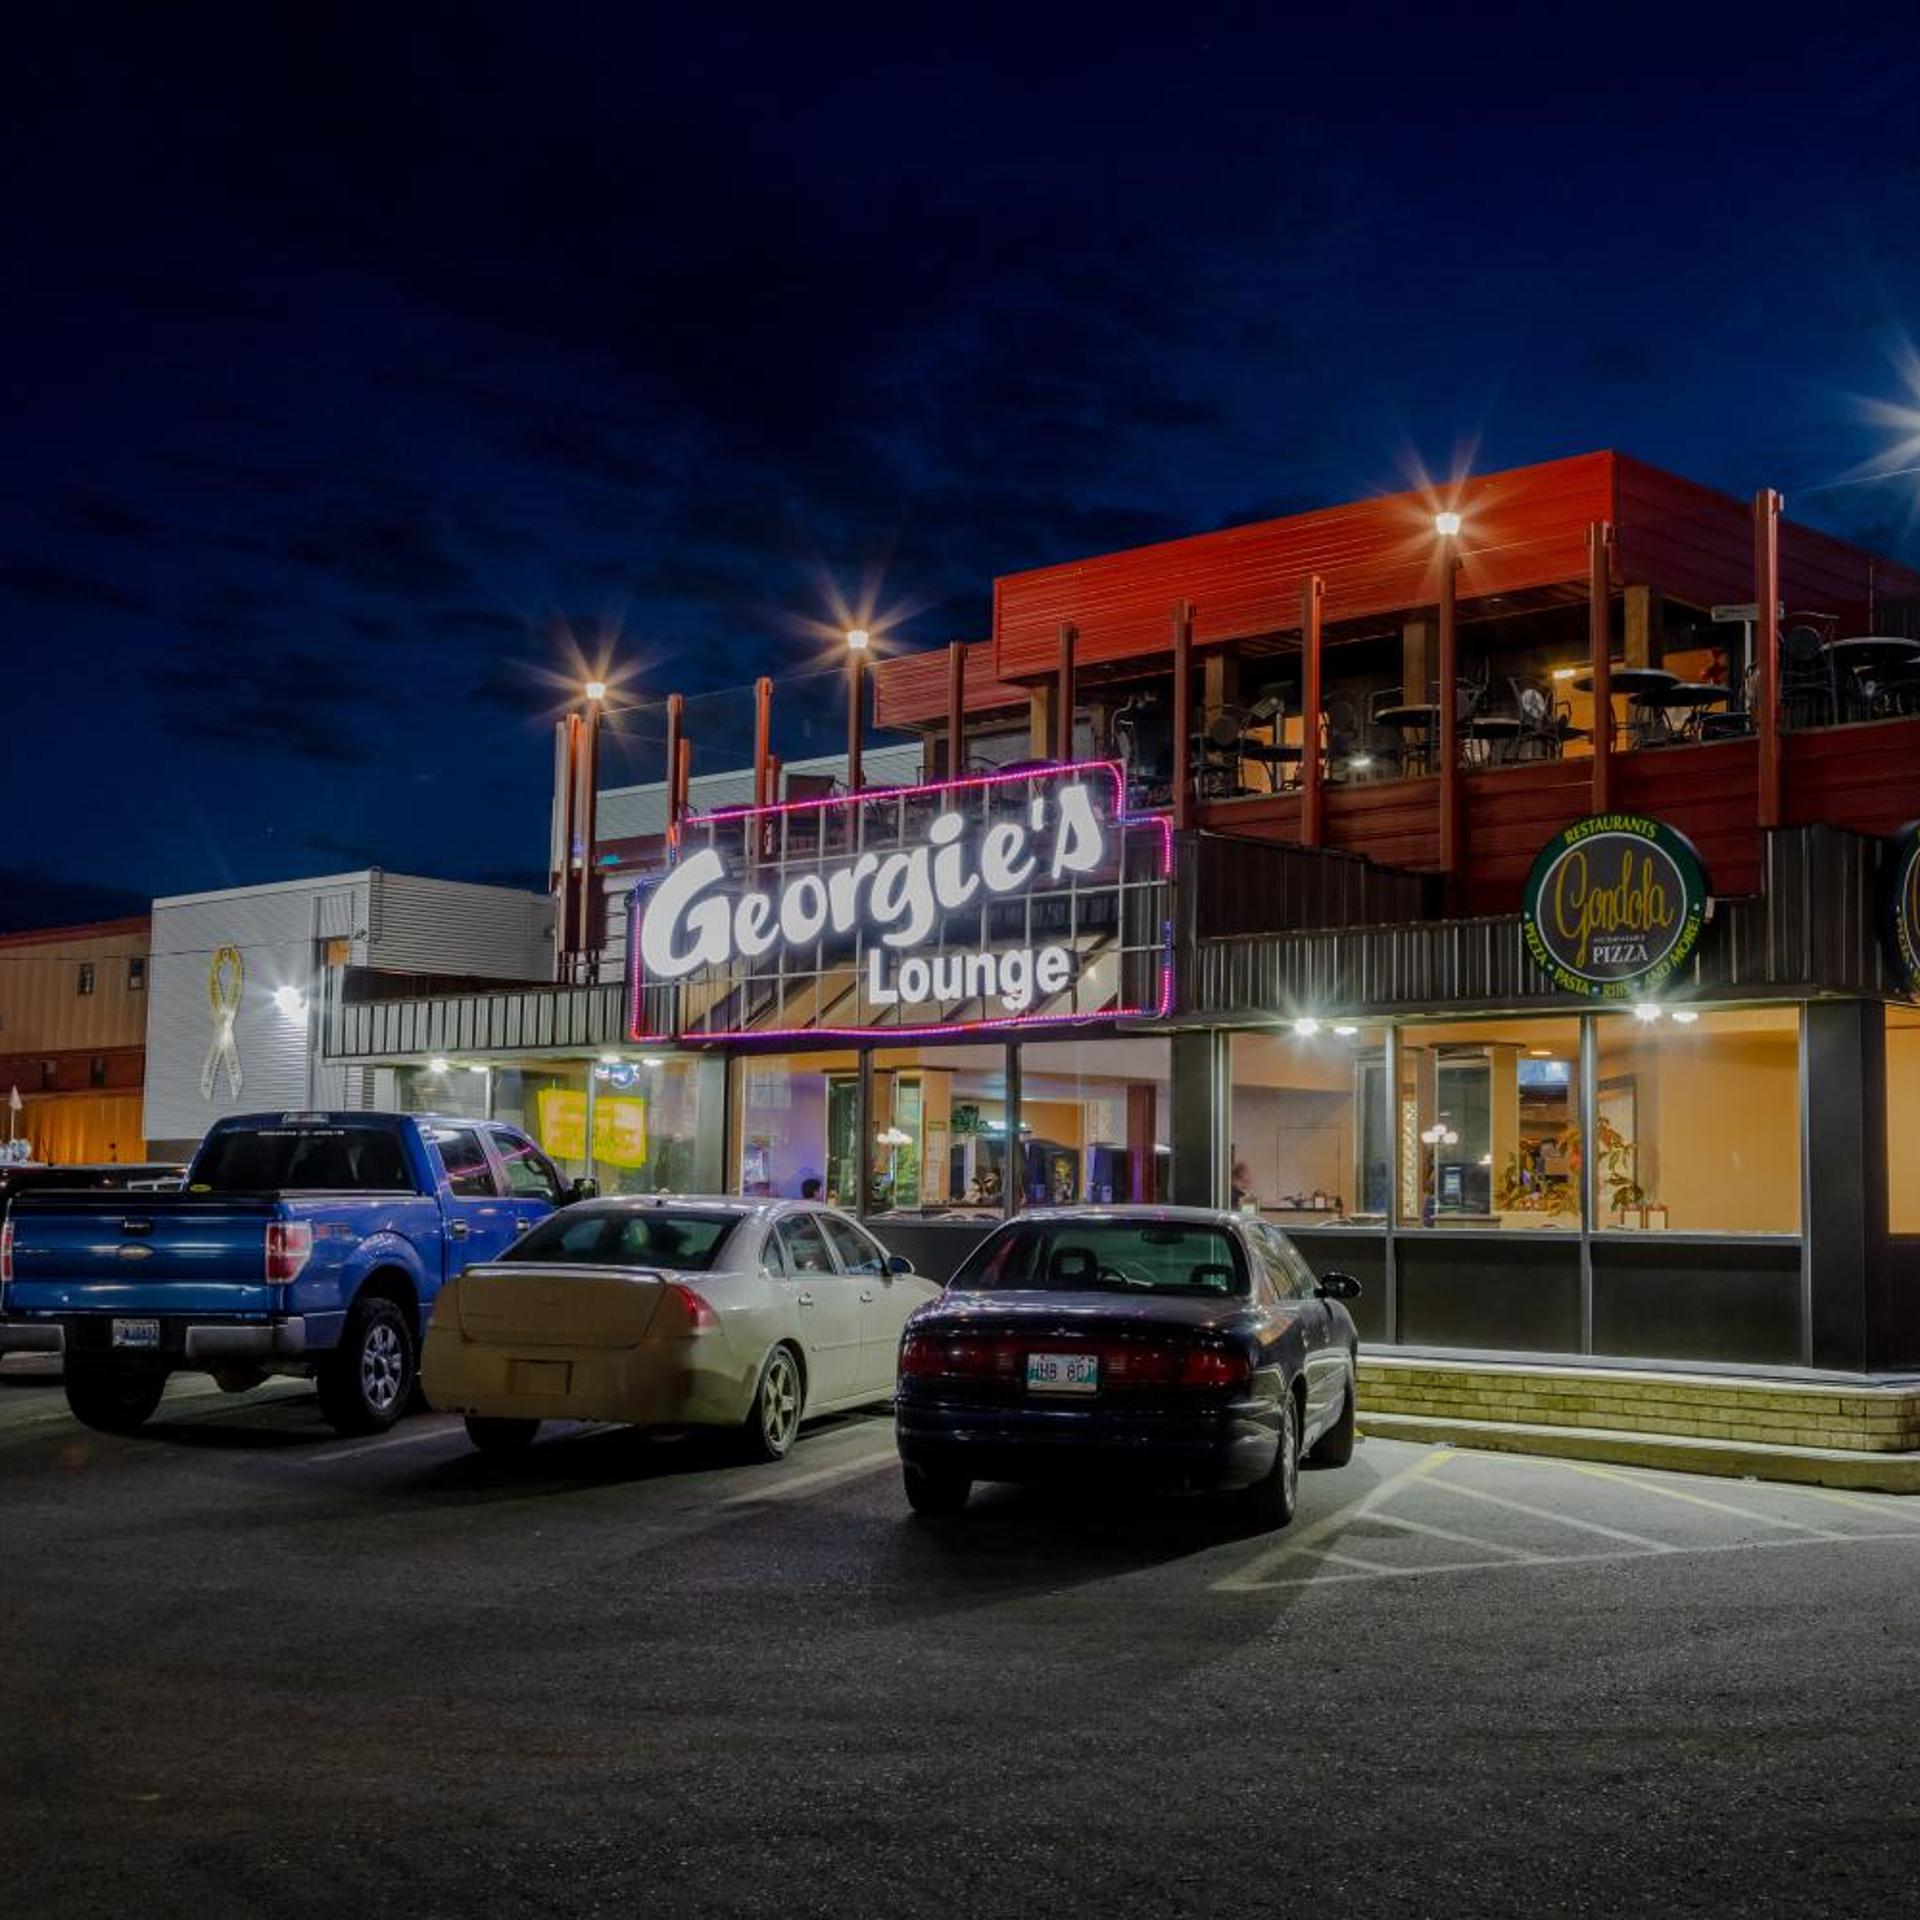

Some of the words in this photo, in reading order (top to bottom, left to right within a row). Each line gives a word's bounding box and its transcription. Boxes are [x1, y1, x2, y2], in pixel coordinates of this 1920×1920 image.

[1564, 815, 1658, 844] RESTAURANTS
[641, 784, 1103, 977] Georgie's
[1555, 849, 1674, 968] Gondola
[868, 946, 1071, 1009] Lounge
[1524, 922, 1547, 967] PIZZA
[1554, 969, 1590, 996] PASTA
[1670, 914, 1702, 967] MORE!
[1592, 943, 1648, 965] PIZZA
